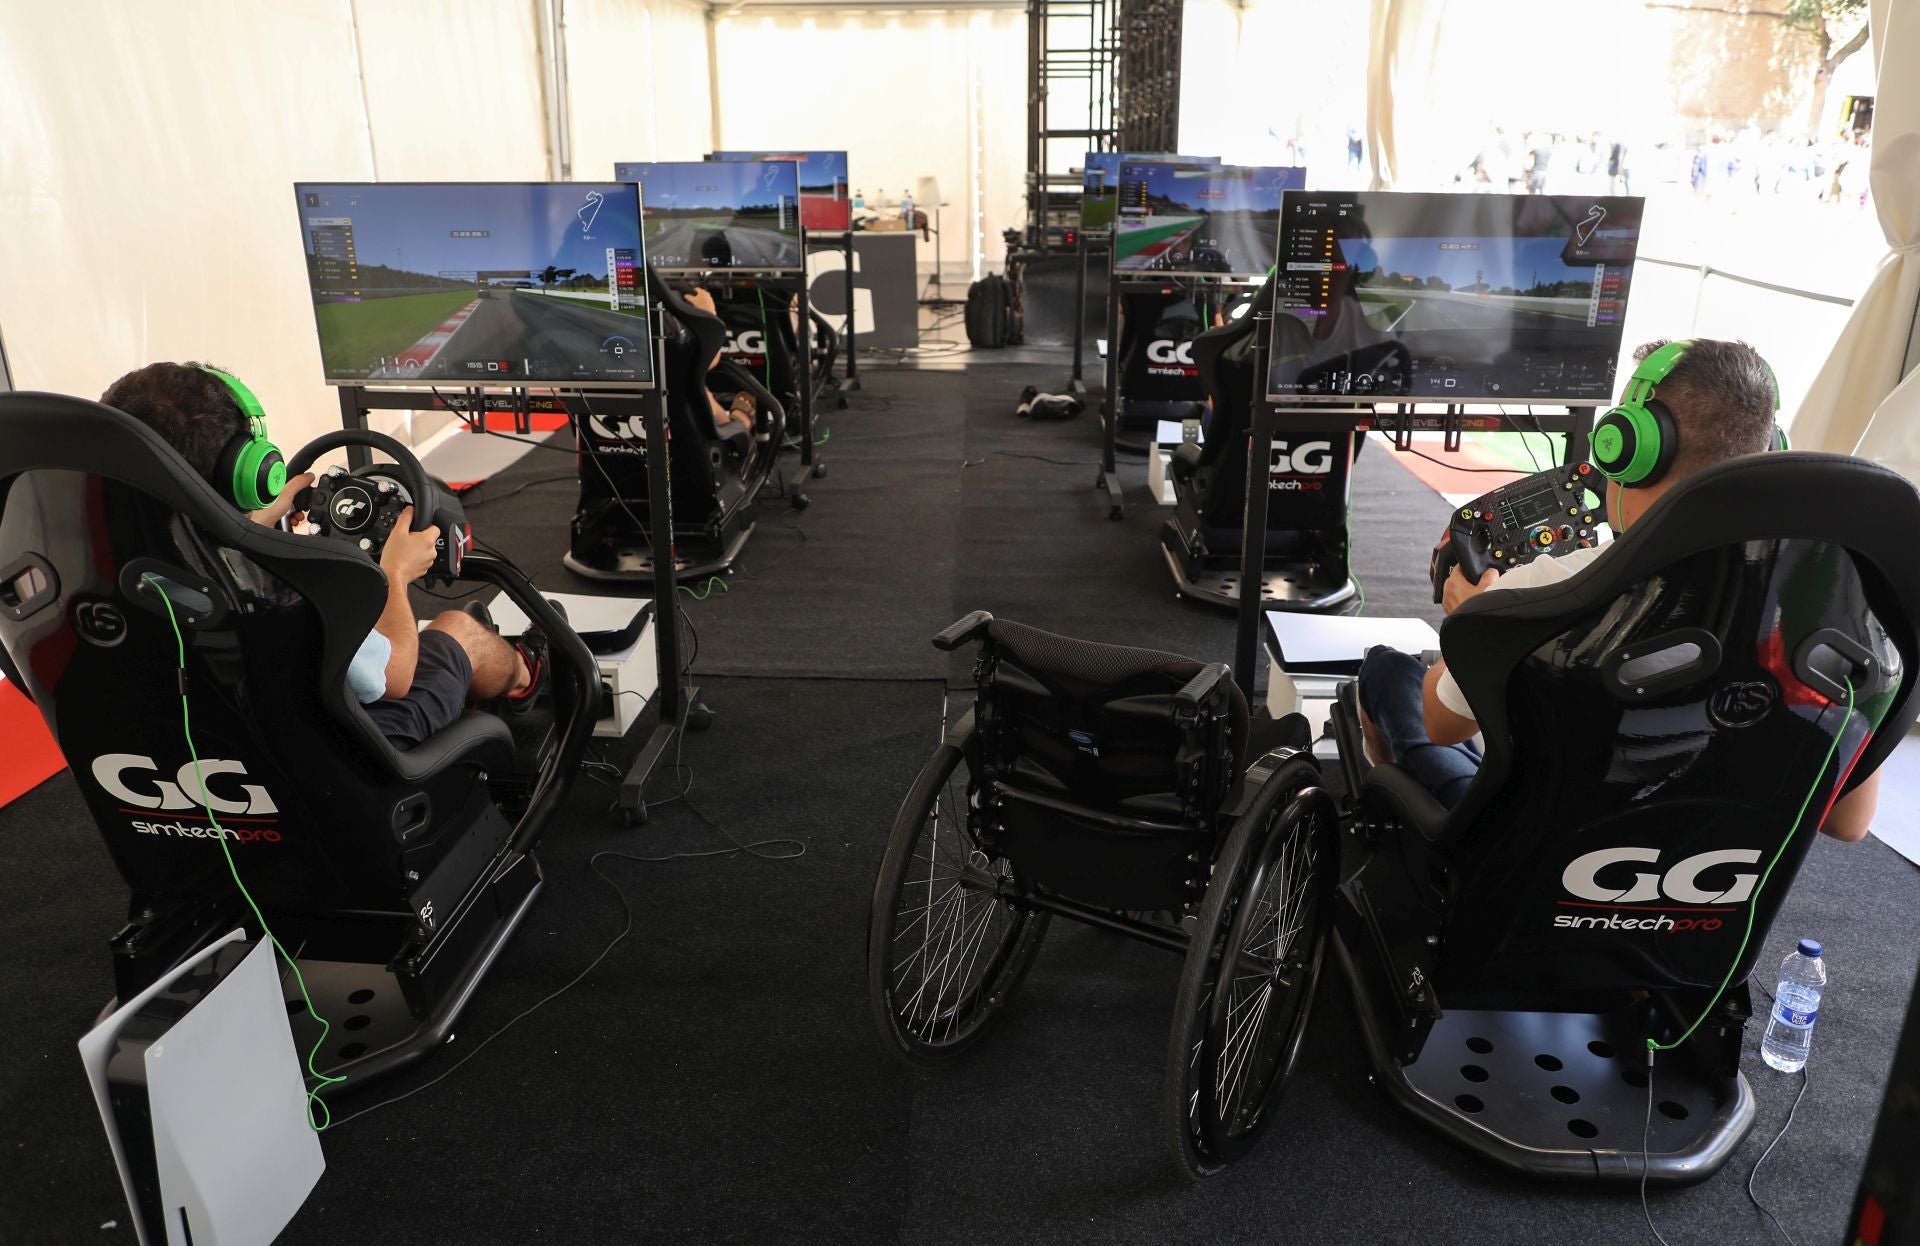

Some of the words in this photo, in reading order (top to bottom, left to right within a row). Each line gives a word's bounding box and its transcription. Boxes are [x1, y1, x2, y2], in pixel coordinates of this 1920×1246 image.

[485, 400, 513, 408] EVEL
[92, 753, 279, 815] GG
[132, 820, 282, 844] simtechpro
[1561, 847, 1762, 904] GG
[1553, 914, 1723, 934] simtechpro
